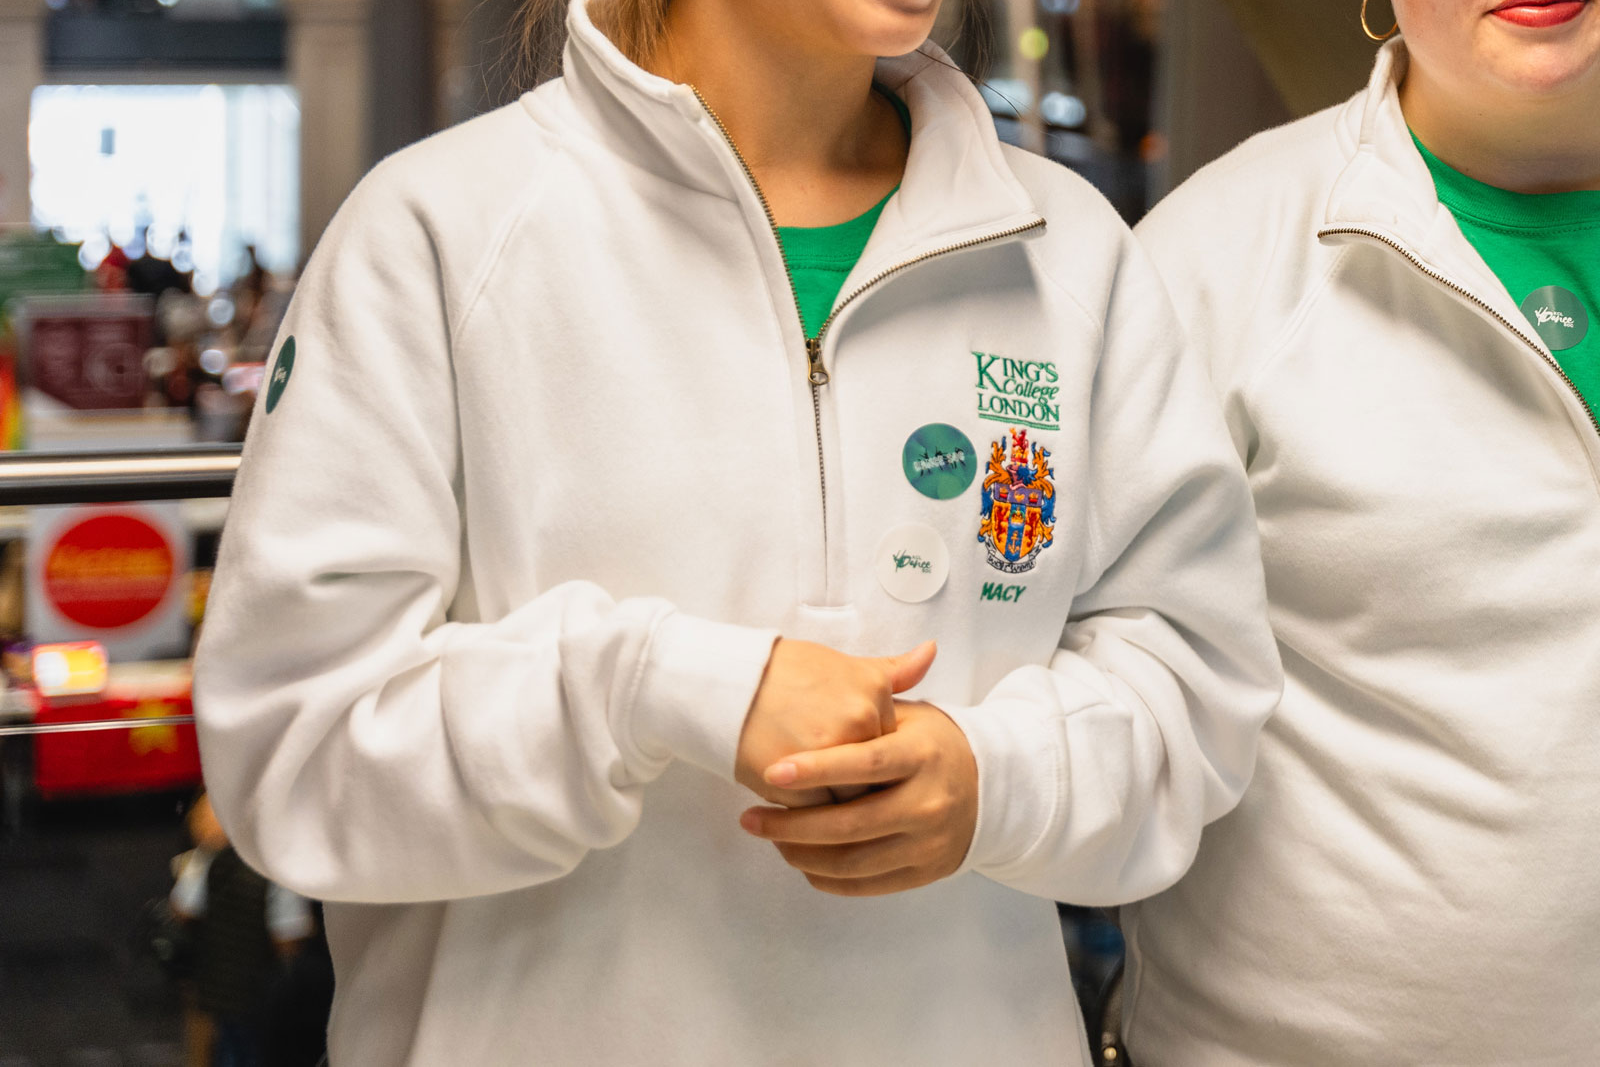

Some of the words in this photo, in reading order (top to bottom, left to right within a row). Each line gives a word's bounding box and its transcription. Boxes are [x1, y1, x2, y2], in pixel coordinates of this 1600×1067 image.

[971, 351, 1059, 393] KING'S
[977, 393, 1060, 423] LONDON
[1002, 378, 1060, 408] College
[980, 582, 1027, 603] MACY
